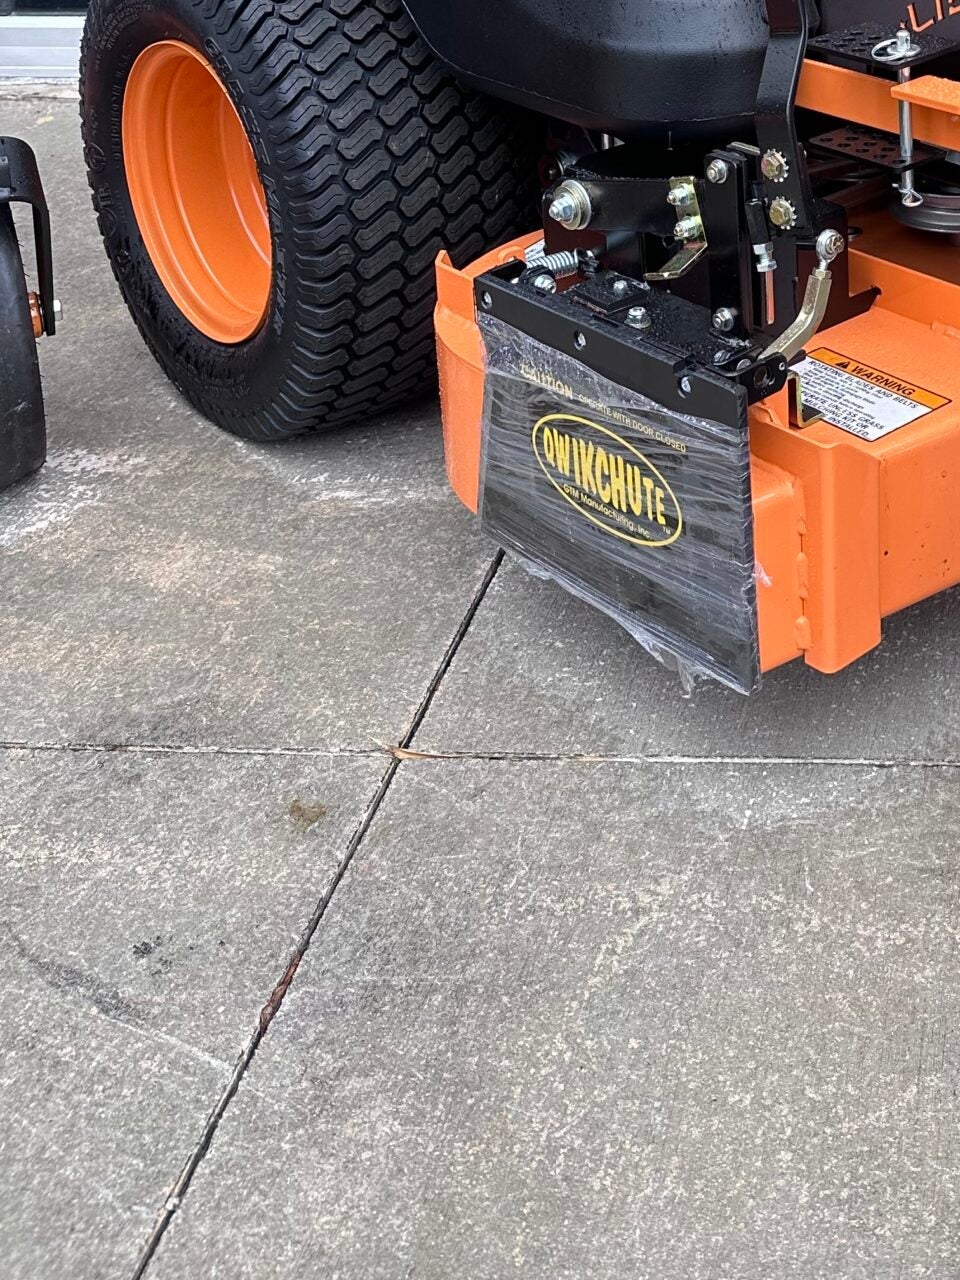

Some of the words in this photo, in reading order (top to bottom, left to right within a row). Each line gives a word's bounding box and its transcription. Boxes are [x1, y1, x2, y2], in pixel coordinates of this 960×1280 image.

[520, 361, 573, 400] CAUTION
[808, 360, 846, 378] ROTATING
[845, 375, 878, 391] BLADES
[876, 388, 894, 399] AND
[893, 396, 919, 410] BELTS
[851, 365, 916, 397] WARNING
[579, 393, 612, 416] OPERATE
[612, 410, 632, 427] WITH
[632, 422, 655, 438] DOOR
[655, 431, 687, 453] CLOSED
[803, 398, 843, 419] MULCHING
[843, 415, 857, 425] KIT
[857, 421, 870, 430] OR
[827, 400, 858, 418] UNLESS
[859, 416, 885, 431] GRASS
[828, 416, 871, 438] INSTALLED
[543, 426, 666, 525] QWIKCHUTE
[563, 483, 580, 499] GTM
